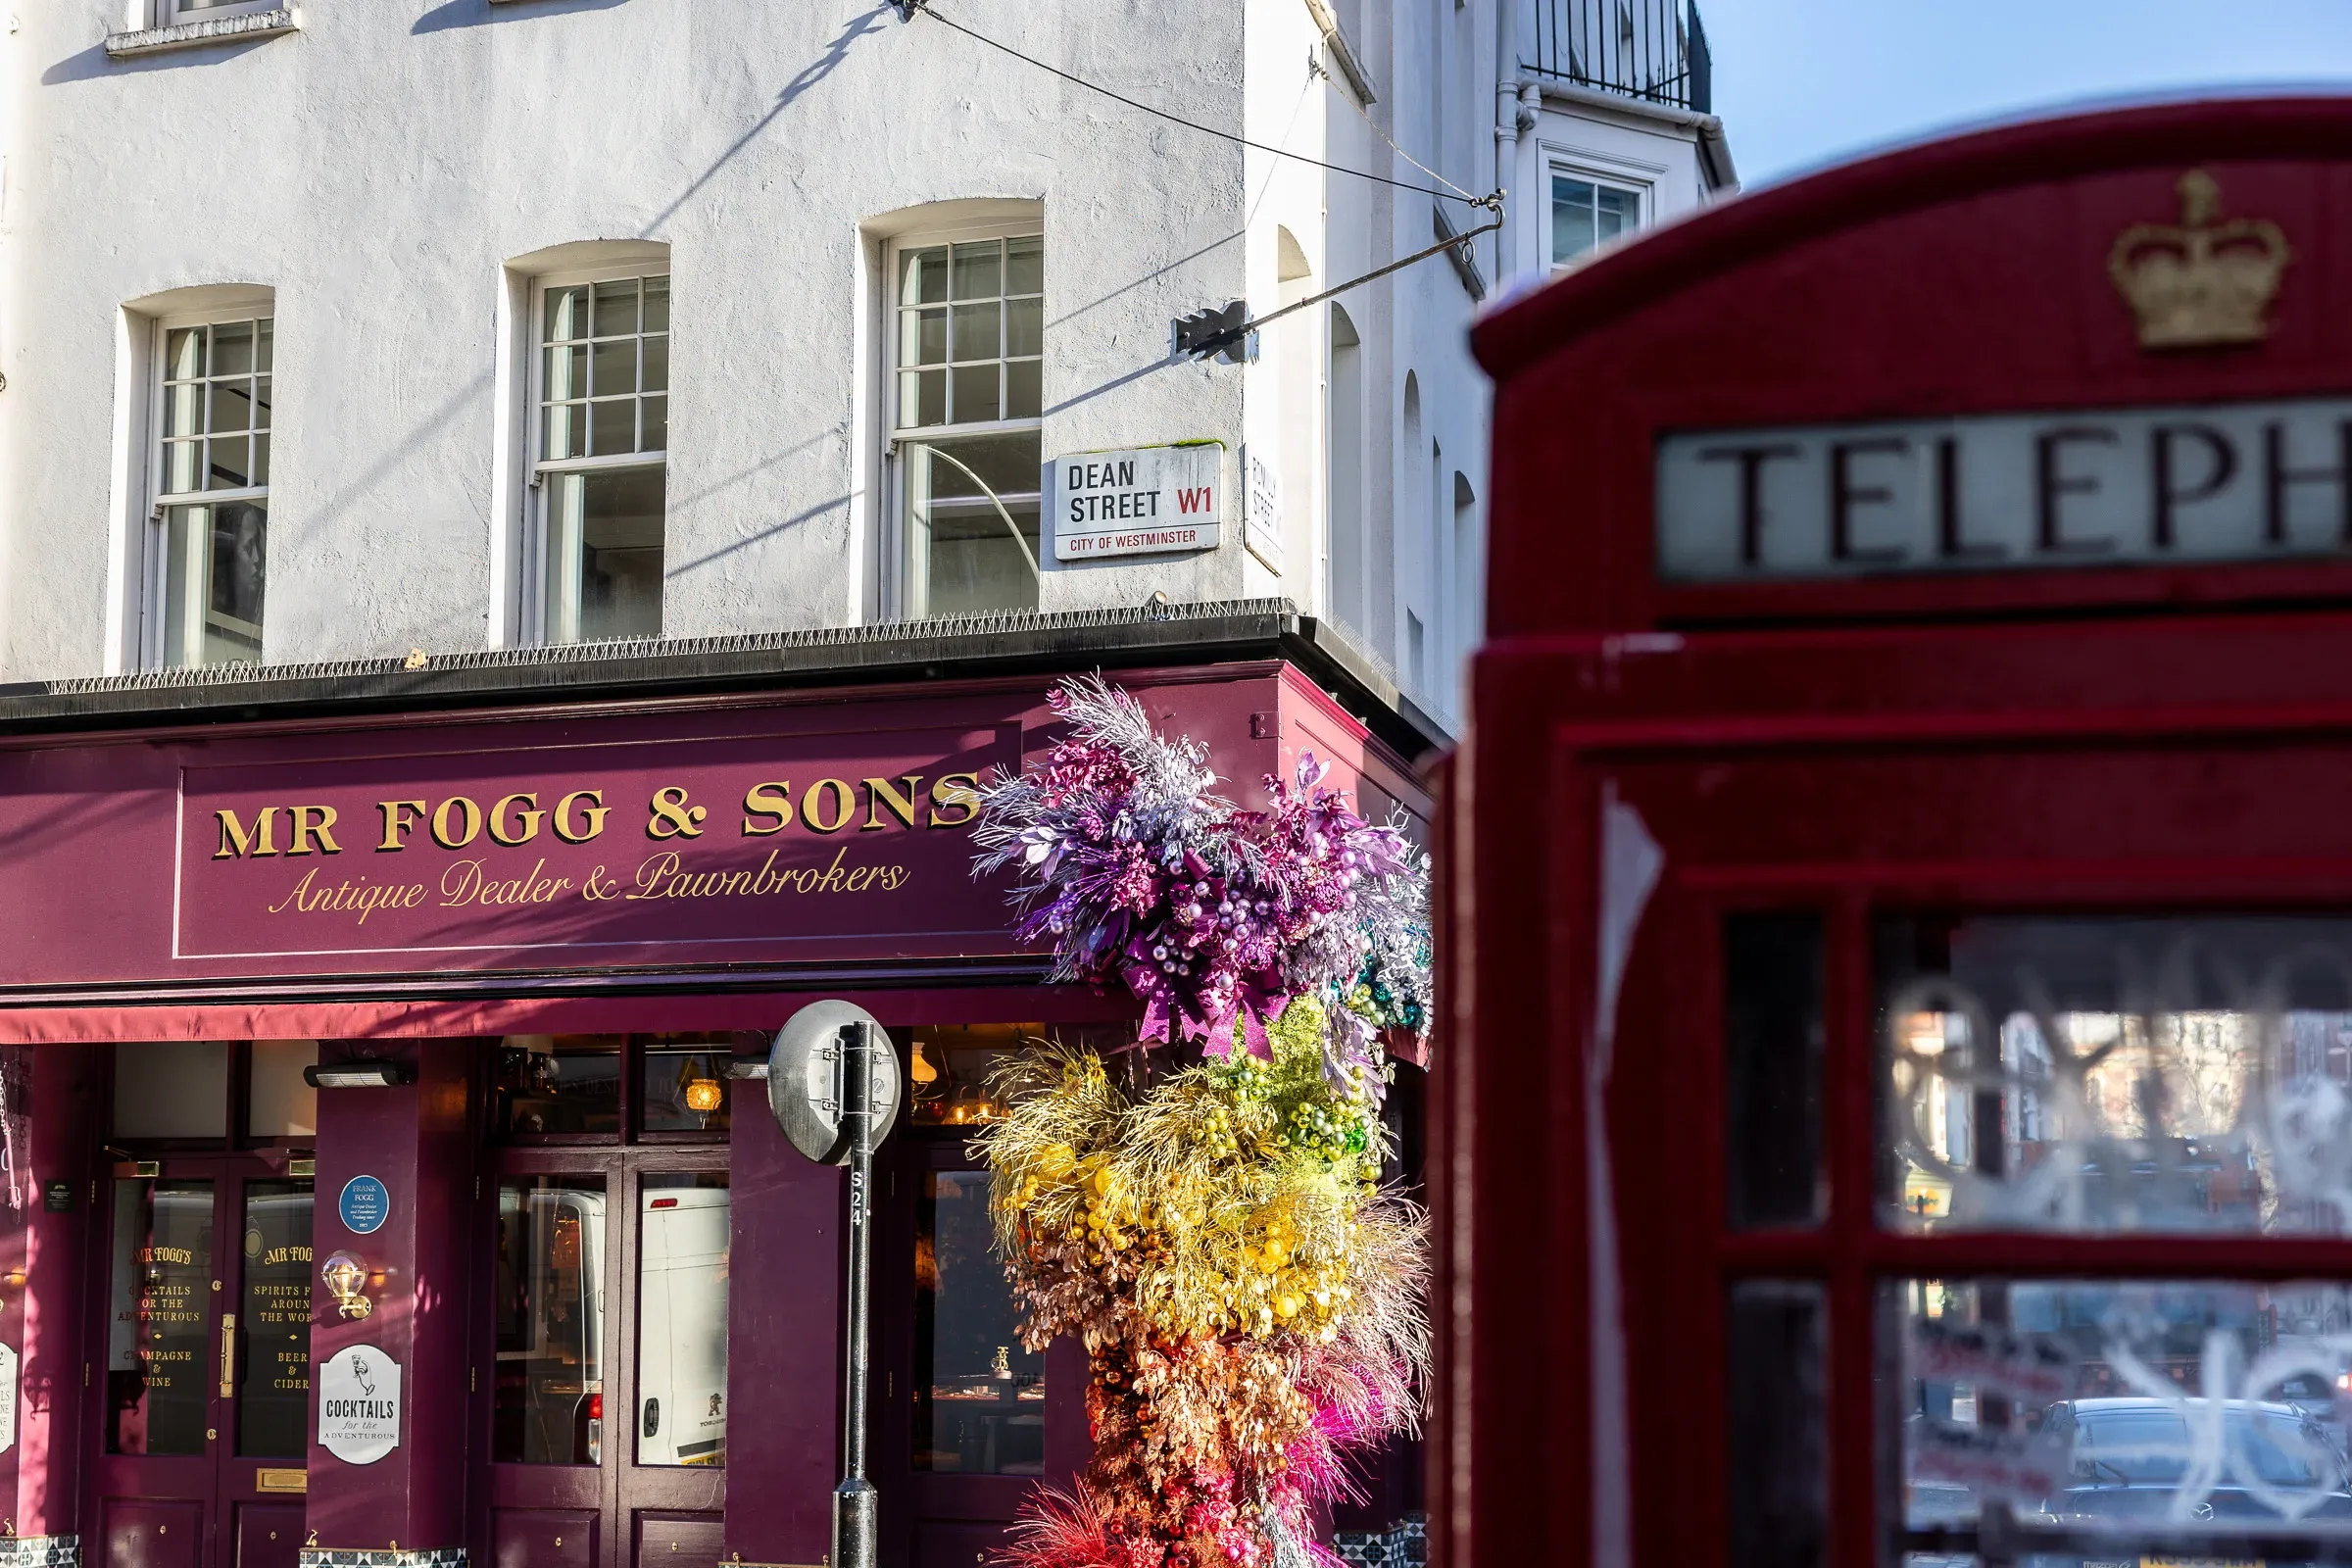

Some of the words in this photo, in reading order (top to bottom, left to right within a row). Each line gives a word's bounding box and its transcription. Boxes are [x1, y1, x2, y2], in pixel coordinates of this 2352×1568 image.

[1069, 461, 1134, 490] DEAN
[1070, 491, 1160, 522] STREET
[1178, 487, 1211, 514] W1
[1070, 538, 1093, 551] CITY
[1099, 536, 1112, 550] OF
[1115, 530, 1196, 548] WESTMINSTER
[212, 805, 342, 859] MR
[374, 789, 610, 853] FOGG
[645, 787, 708, 841] &
[742, 771, 981, 836] SONS
[269, 866, 428, 924] Antique
[440, 858, 574, 906] Dealer
[583, 864, 620, 901] &
[626, 847, 910, 900] Pawnbrokers
[154, 1247, 191, 1264] FOGG'S
[265, 1247, 288, 1264] MR
[129, 1286, 190, 1295] CCKTAILS
[254, 1286, 299, 1295] SPIRITS
[162, 1298, 183, 1307] THE
[270, 1299, 310, 1308] AROUN
[118, 1312, 200, 1321] ADENTUROUS
[260, 1312, 282, 1321] THE
[123, 1351, 191, 1360] CAMPAGNE
[277, 1352, 308, 1362] BEER
[153, 1364, 161, 1373] &
[288, 1365, 297, 1375] &
[273, 1379, 310, 1389] CIDER
[326, 1399, 394, 1419] COCKTAILS
[342, 1420, 359, 1430] for
[362, 1421, 378, 1430] the
